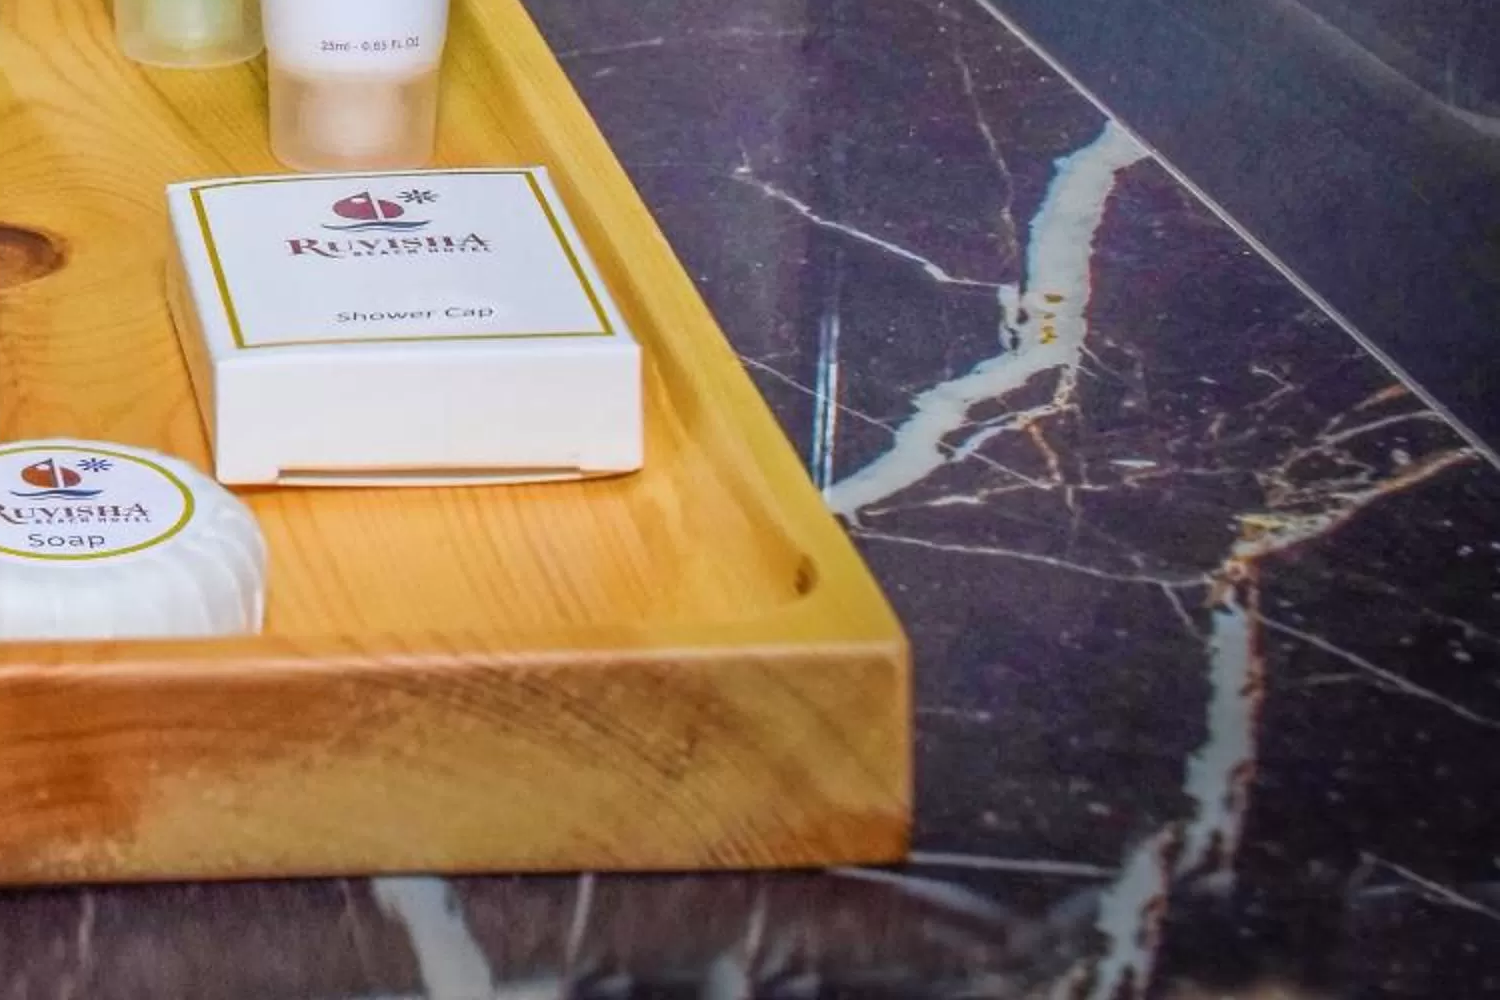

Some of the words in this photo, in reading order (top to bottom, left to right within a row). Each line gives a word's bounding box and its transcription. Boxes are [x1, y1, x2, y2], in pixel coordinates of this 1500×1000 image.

[284, 232, 491, 258] RUVISHA
[336, 309, 433, 323] Shower
[444, 305, 495, 319] Cap
[27, 533, 105, 549] Soap
